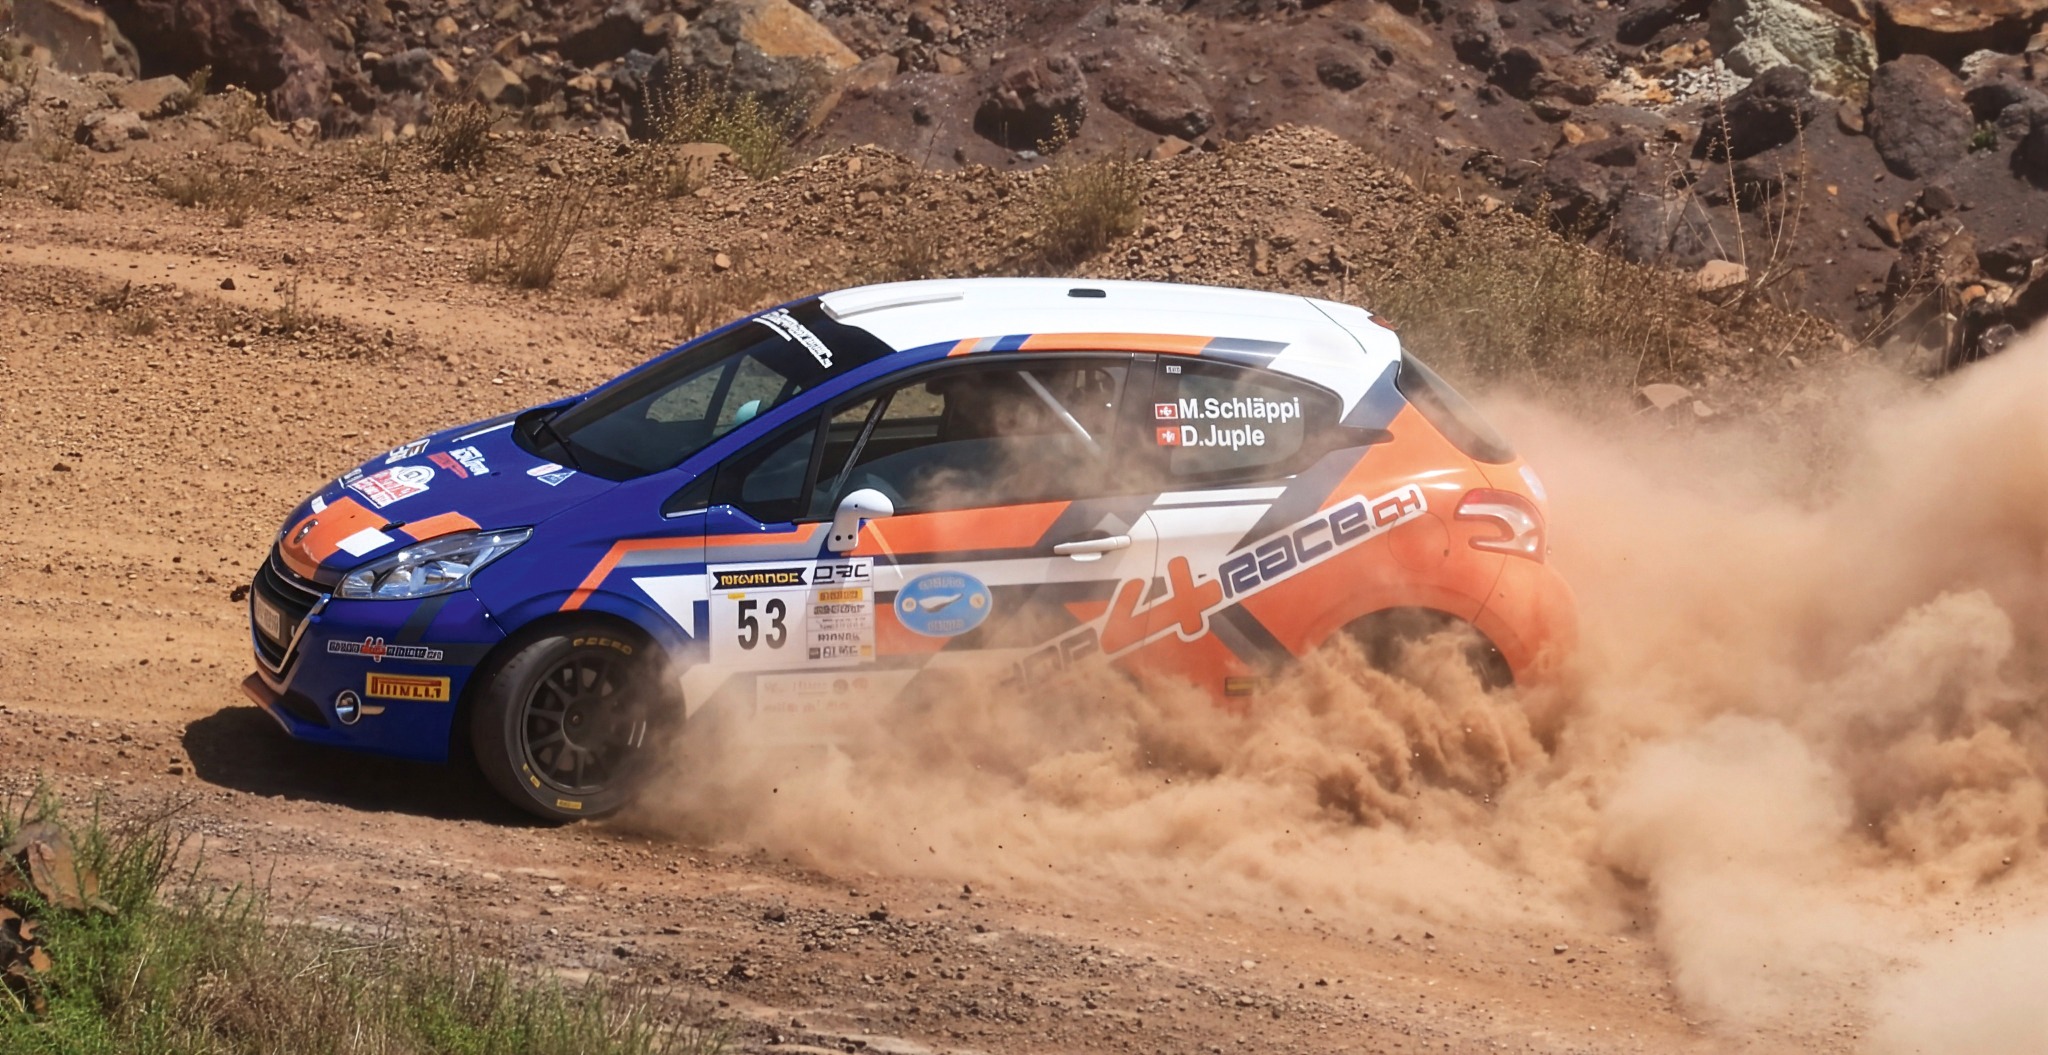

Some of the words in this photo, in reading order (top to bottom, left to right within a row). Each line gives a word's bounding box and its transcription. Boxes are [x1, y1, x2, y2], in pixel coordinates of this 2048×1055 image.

[1178, 397, 1300, 423] M.Schläppi
[1180, 424, 1266, 451] D.Juple
[738, 598, 787, 650] 53
